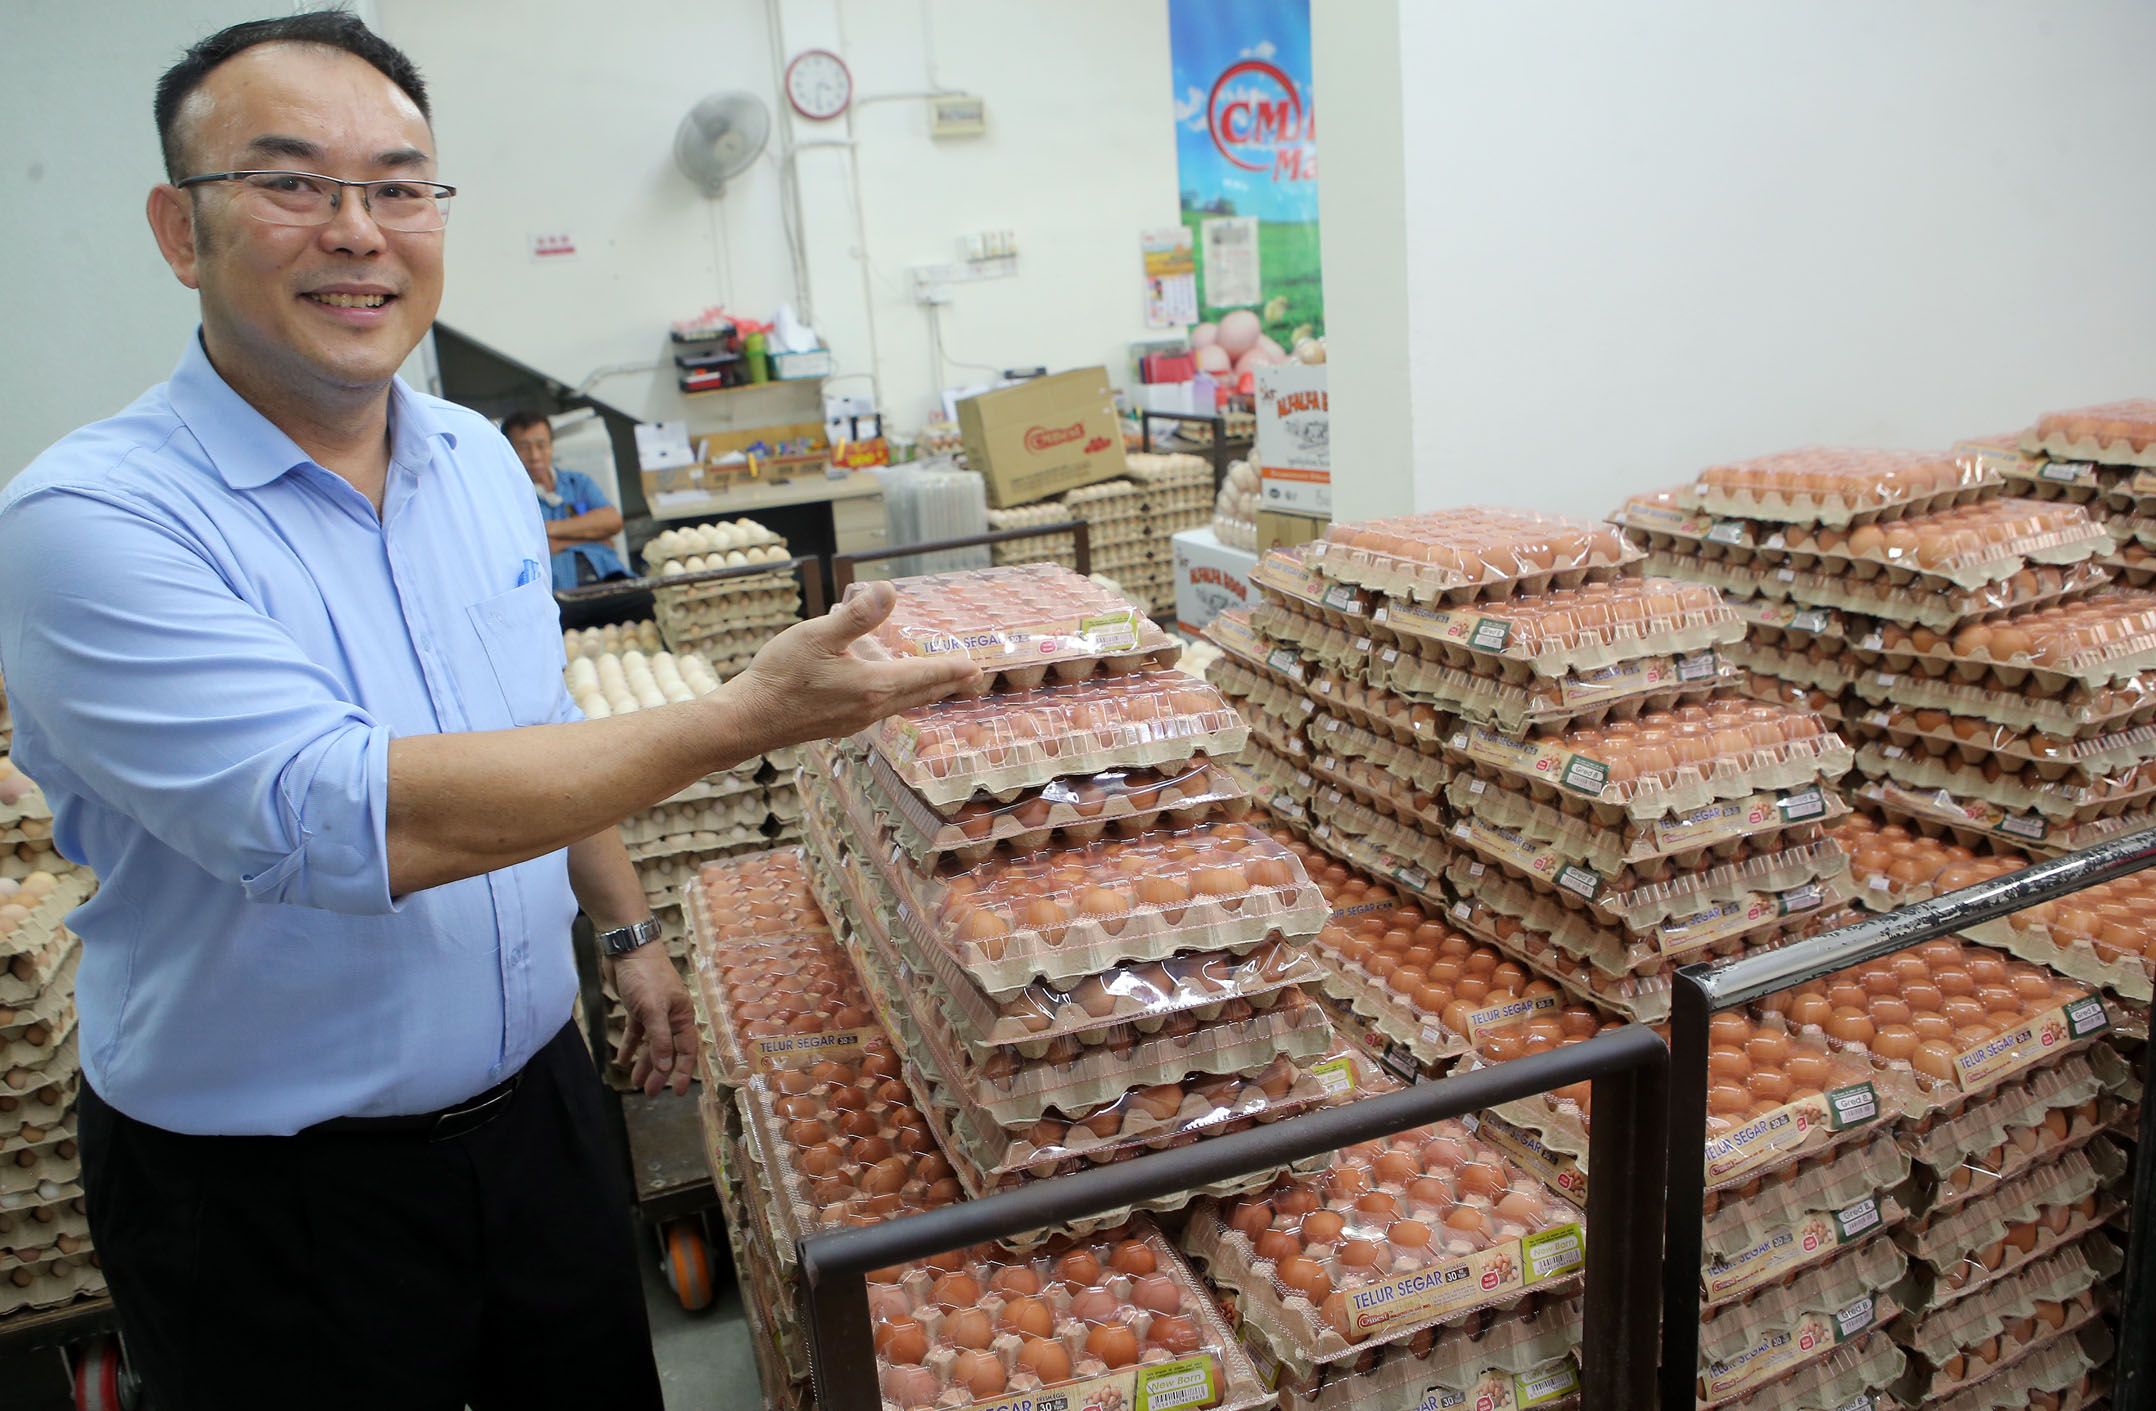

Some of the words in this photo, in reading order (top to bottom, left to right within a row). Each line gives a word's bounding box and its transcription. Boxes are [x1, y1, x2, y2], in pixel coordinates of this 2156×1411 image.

[1221, 101, 1315, 142] CM
[1575, 766, 1591, 777] Gred
[1570, 868, 1588, 880] Gred
[1347, 903, 1375, 916] SEGAR
[1472, 1009, 1501, 1025] TELUR
[1502, 1000, 1534, 1017] SEGAR
[2075, 1008, 2091, 1019] Gred
[760, 1039, 793, 1053] TELUR
[797, 1035, 835, 1048] SEGAR
[1960, 1049, 1987, 1070] TELUR
[1987, 1035, 2016, 1057] SEGAR
[1840, 1096, 1862, 1108] Gred
[1704, 1139, 1734, 1160] TELUR
[1733, 1121, 1768, 1146] SEGAR
[1843, 1206, 1863, 1220] Gred
[1534, 1245, 1553, 1257] New
[1554, 1239, 1576, 1251] Born
[1353, 1286, 1394, 1310] TELUR
[1399, 1270, 1444, 1297] SEGAR
[1446, 1271, 1458, 1282] 30
[1841, 1304, 1861, 1319] Gred
[1152, 1380, 1174, 1390] New
[1177, 1374, 1201, 1385] Born
[1039, 1402, 1052, 1411] 30
[1443, 1396, 1454, 1407] 30
